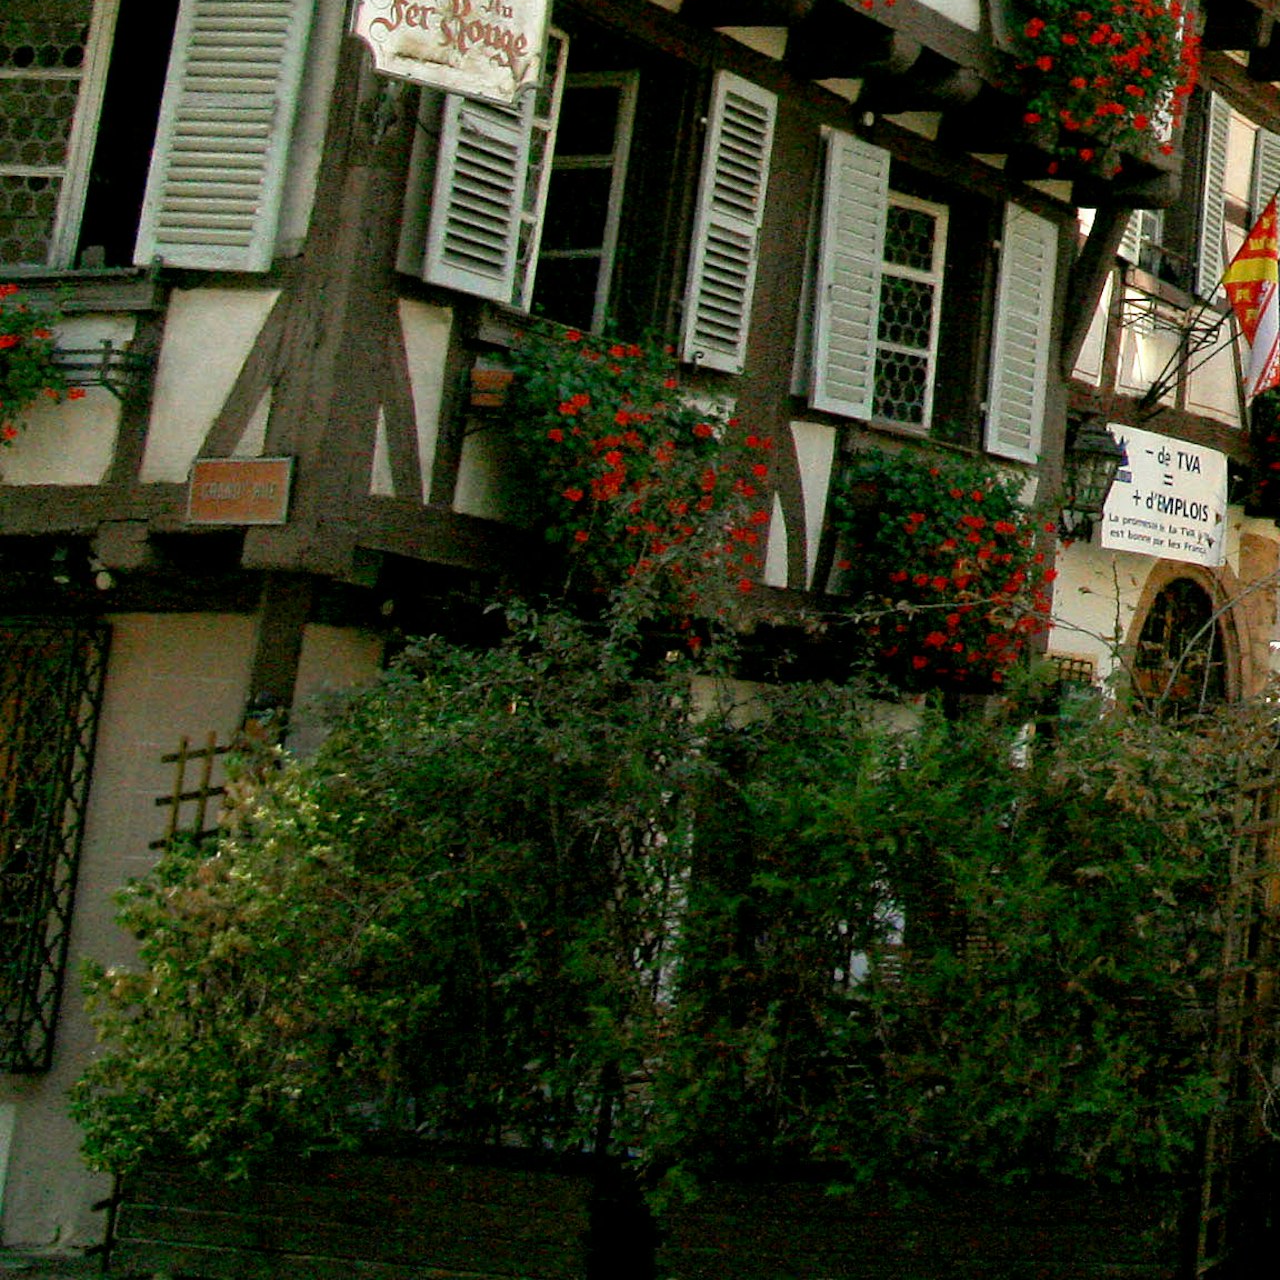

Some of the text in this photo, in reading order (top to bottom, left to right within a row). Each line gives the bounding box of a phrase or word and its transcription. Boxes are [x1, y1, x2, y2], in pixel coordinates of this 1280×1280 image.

[1157, 445, 1171, 467] de
[1177, 450, 1201, 474] TVA
[1109, 512, 1119, 523] La
[1145, 491, 1209, 523] d'EMPLOIS
